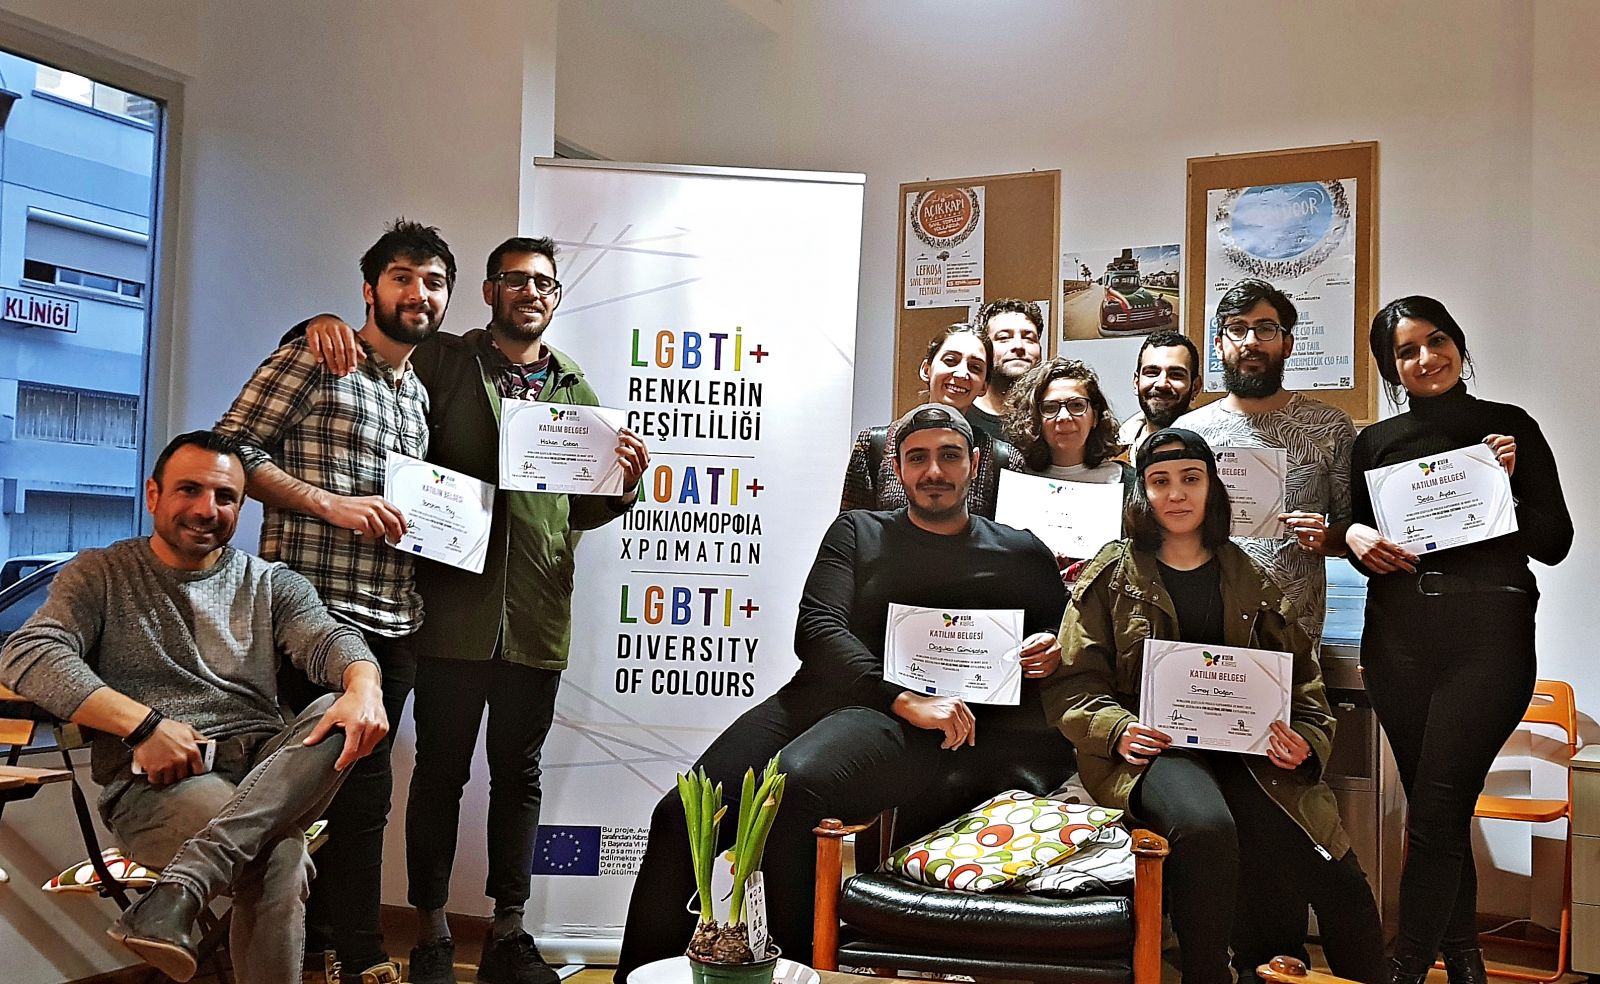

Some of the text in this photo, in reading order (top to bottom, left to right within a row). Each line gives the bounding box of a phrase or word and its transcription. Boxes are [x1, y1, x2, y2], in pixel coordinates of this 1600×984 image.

[945, 198, 964, 213] KAPI
[916, 264, 942, 276] LEFKOŞA
[6, 297, 69, 327] KLİNİĞİ
[1312, 326, 1324, 334] FAIR
[632, 326, 768, 371] LGBTİ+
[1307, 341, 1320, 350] FAIR
[1336, 356, 1348, 364] FAIR
[628, 377, 762, 407] RENKLERİN
[538, 424, 588, 435] KATILIM BELGESİ
[1412, 471, 1466, 491] KATILIM BELGESİ
[622, 510, 762, 535] ΠΟΙΚΙΛΟΜΟΡΦΙΑ
[620, 538, 760, 564] ΧΡΩΜΑΤΩΝ
[620, 585, 759, 626] LGBTI+
[930, 630, 983, 640] KATILIM BELGESİ
[618, 634, 759, 663] DIVERSITY
[616, 668, 754, 697] OF COLOURS
[1190, 670, 1246, 682] KATILIM BELGESİ
